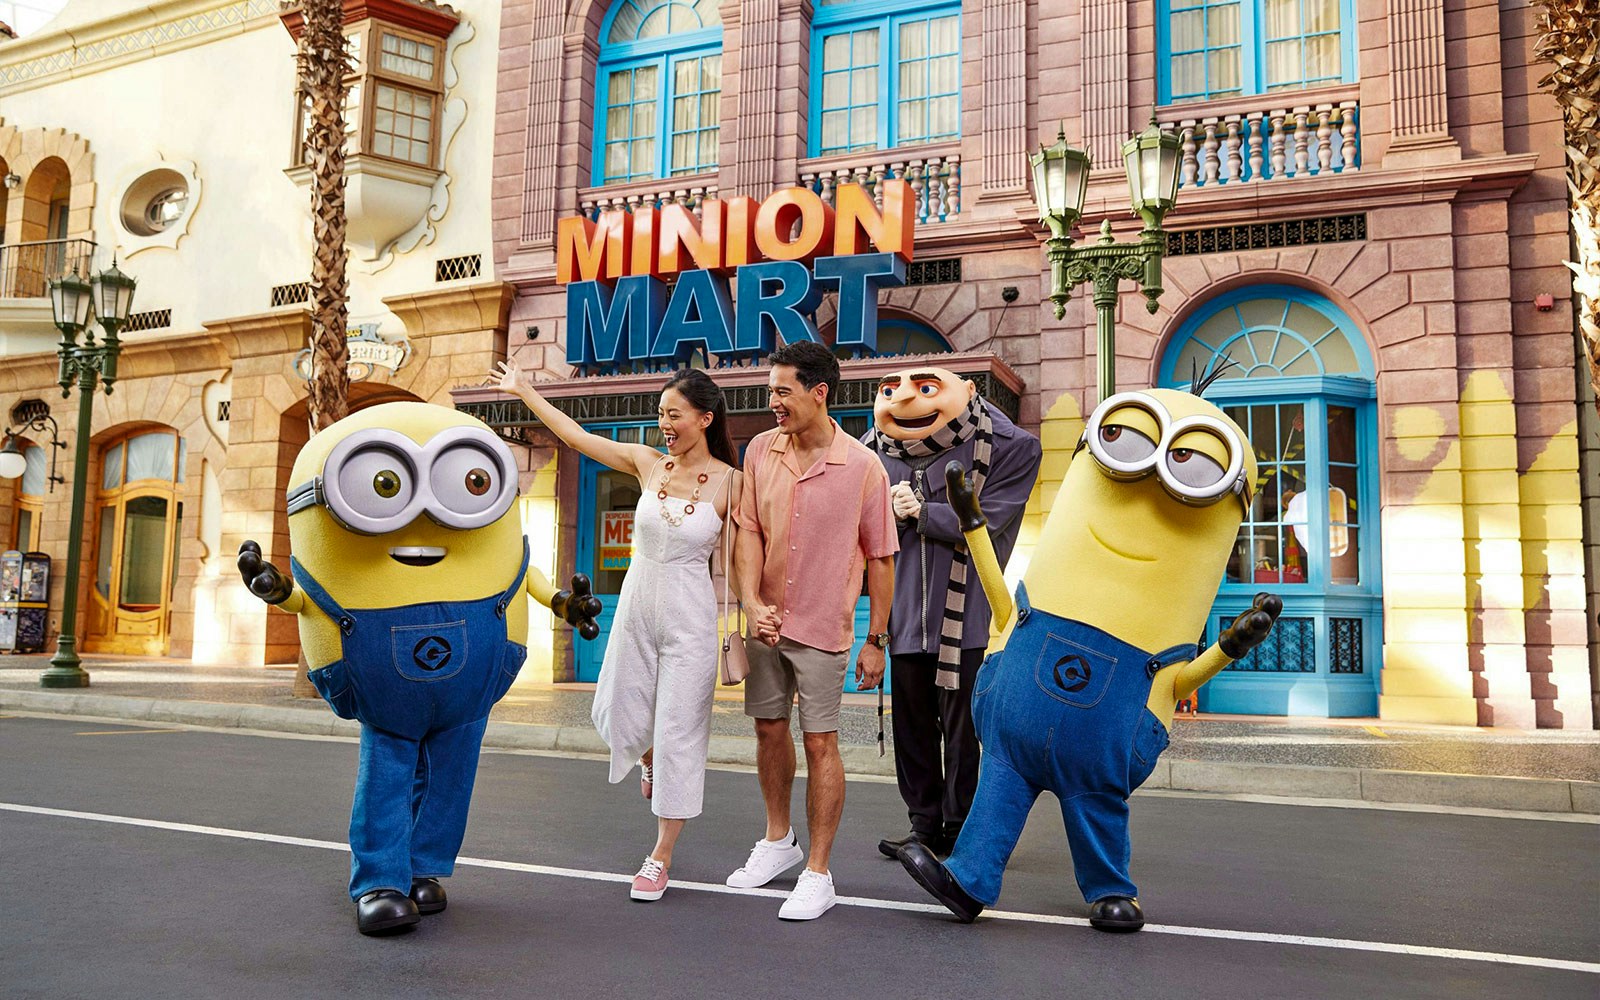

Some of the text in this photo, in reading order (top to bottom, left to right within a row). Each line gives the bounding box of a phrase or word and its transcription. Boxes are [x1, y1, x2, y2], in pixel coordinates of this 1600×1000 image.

[556, 178, 910, 285] MINION
[566, 252, 902, 364] MART
[604, 520, 634, 544] ME
